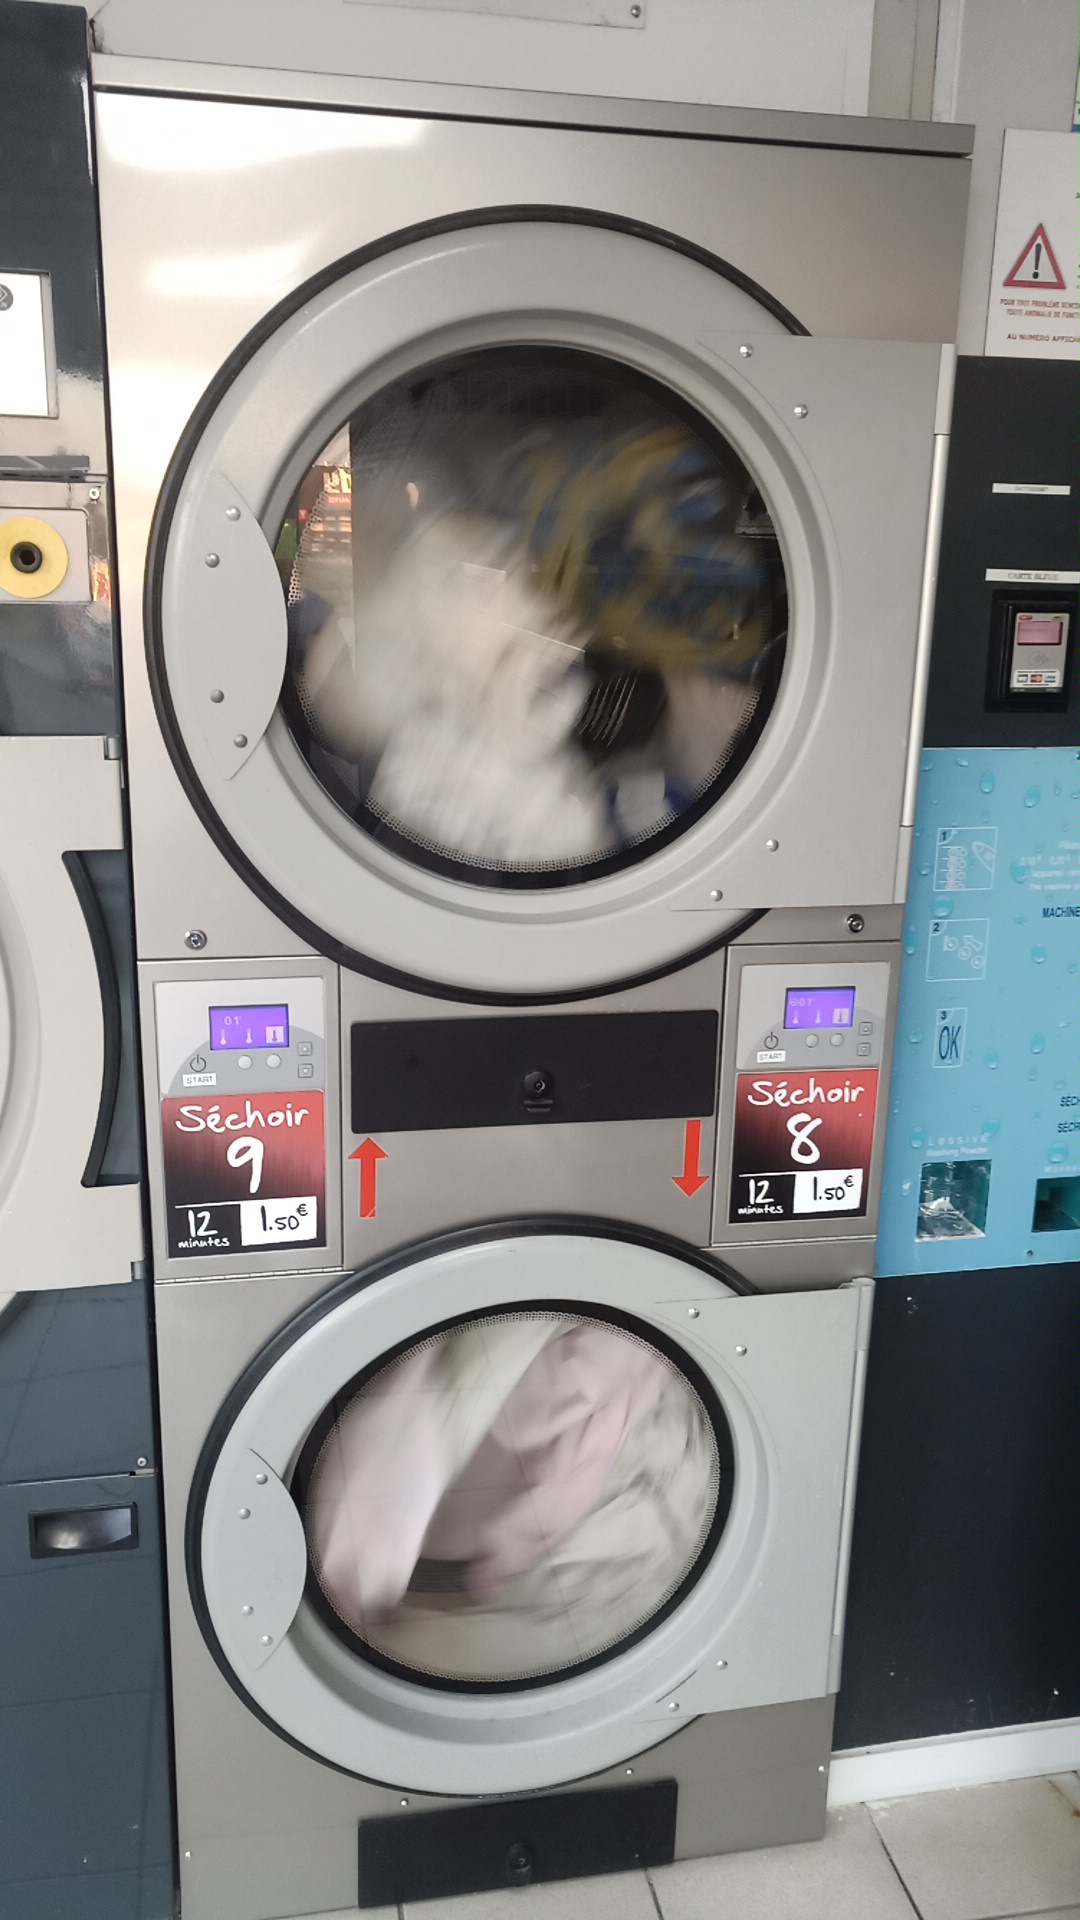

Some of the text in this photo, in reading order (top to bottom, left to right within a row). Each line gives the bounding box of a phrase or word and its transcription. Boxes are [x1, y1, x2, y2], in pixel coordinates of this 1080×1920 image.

[933, 922, 940, 932] 2
[940, 1010, 947, 1020] 3
[938, 1025, 961, 1060] OK
[758, 1053, 783, 1062] START
[186, 1074, 214, 1085] START
[747, 1077, 865, 1108] Séchoir
[175, 1100, 309, 1133] Séchoir
[786, 1112, 823, 1165] 8
[226, 1136, 265, 1194] 9
[749, 1178, 775, 1205] 12
[813, 1174, 854, 1202] 1.50€
[187, 1209, 218, 1238] 12
[260, 1203, 308, 1232] 1.50€
[737, 1204, 784, 1215] minutes
[178, 1236, 230, 1249] minutes
